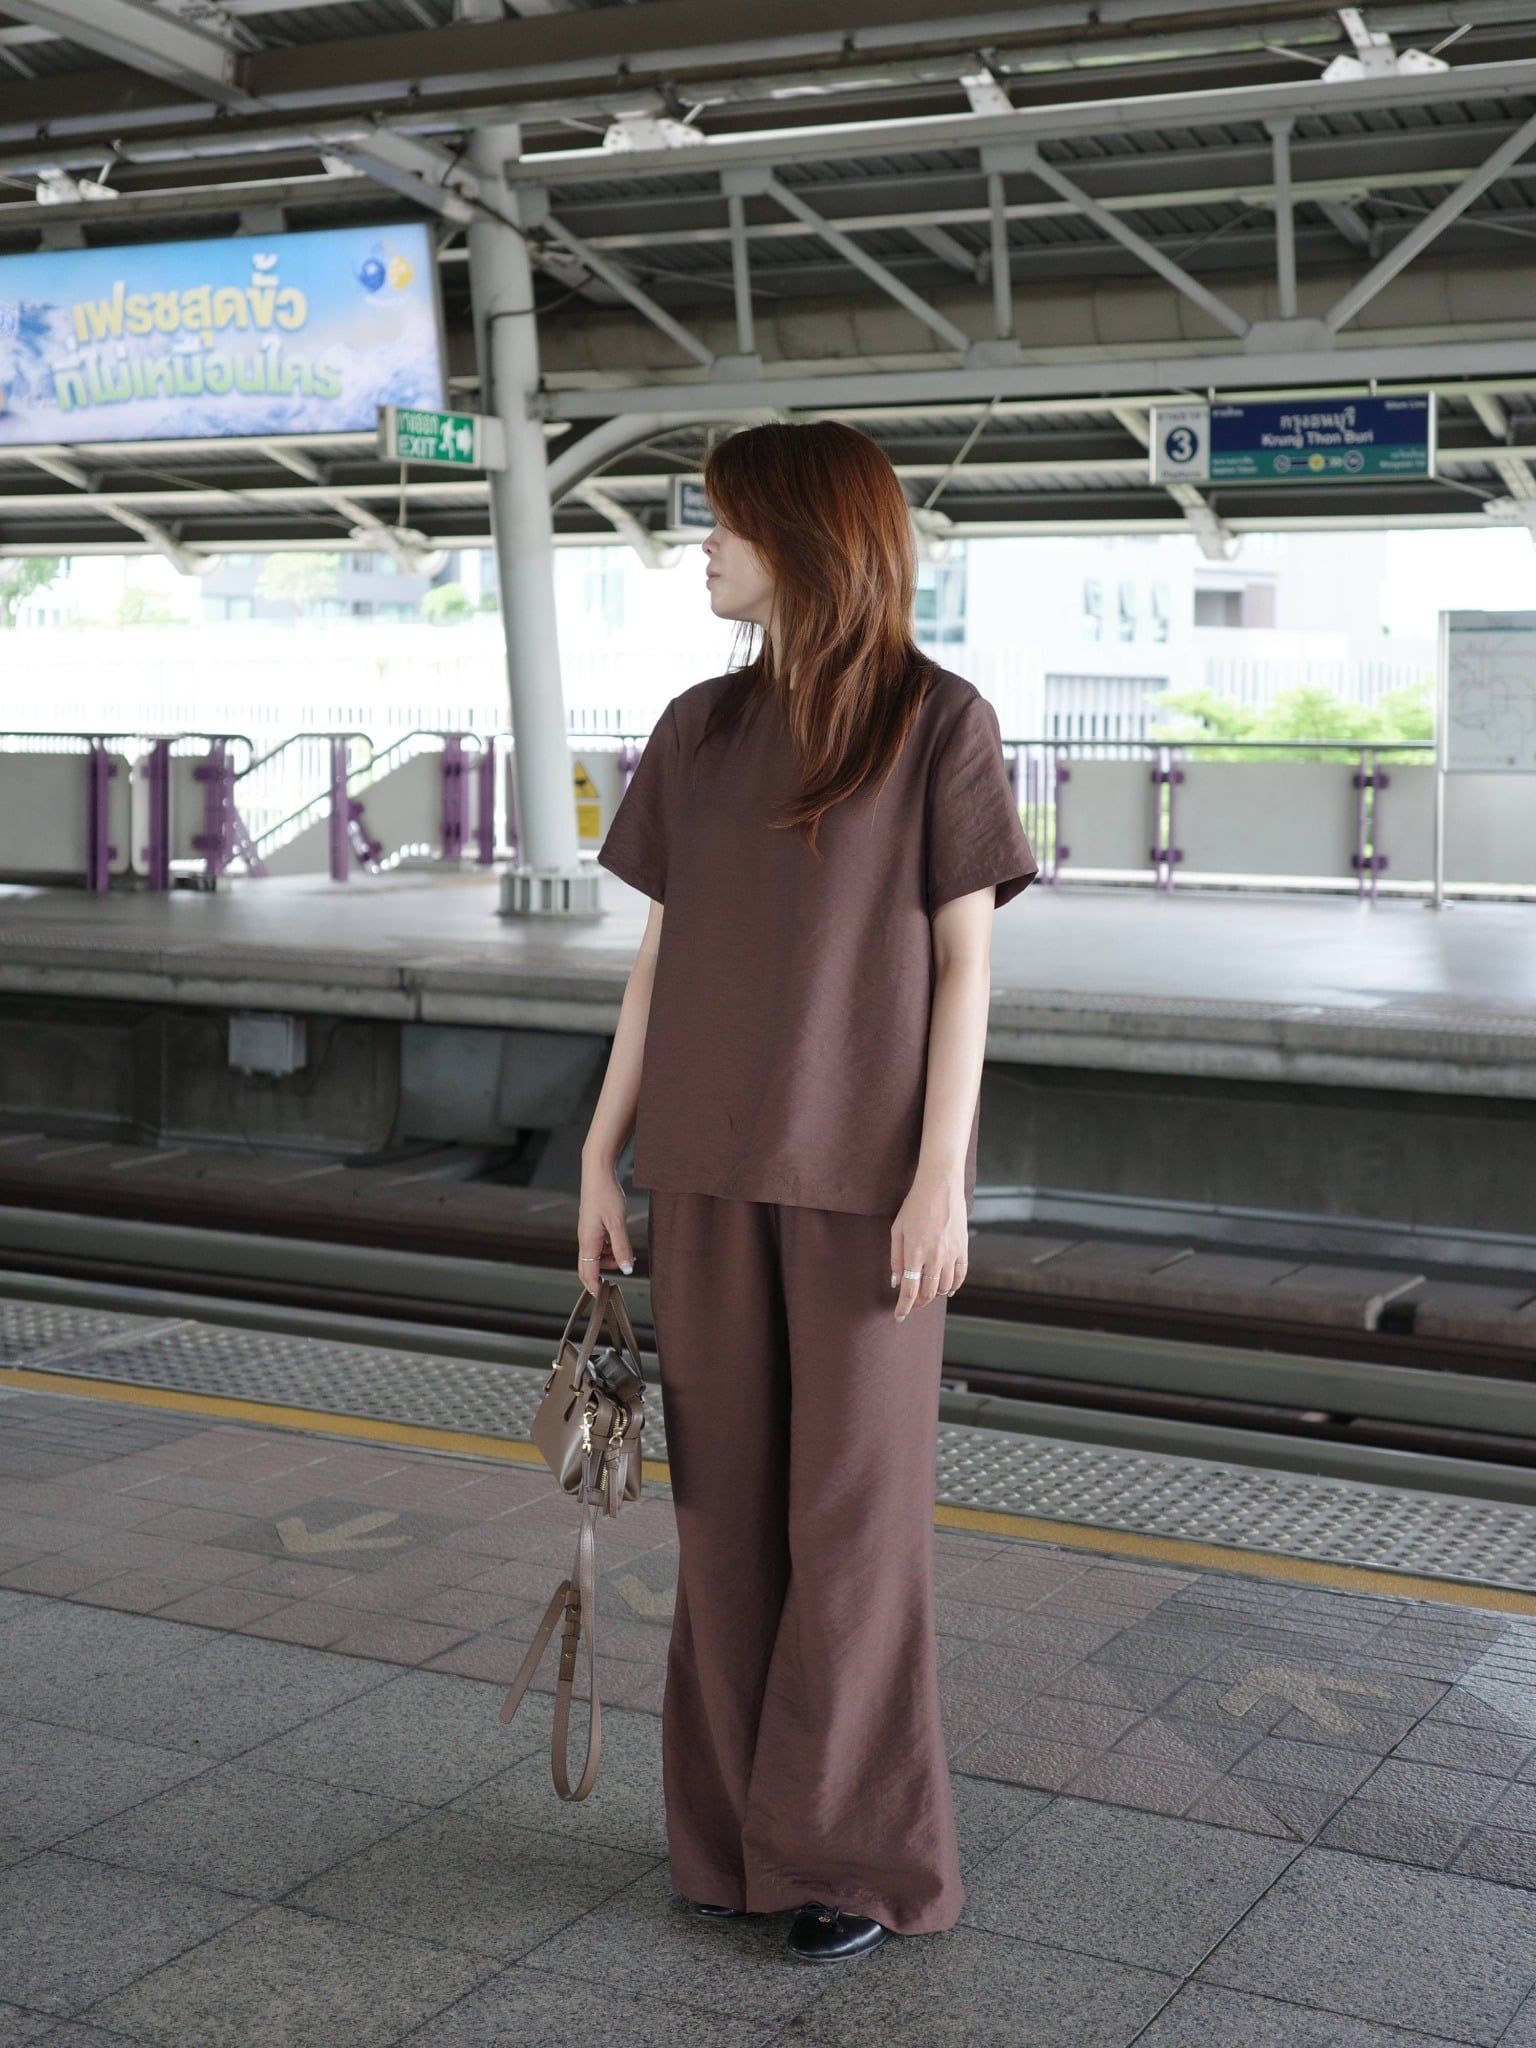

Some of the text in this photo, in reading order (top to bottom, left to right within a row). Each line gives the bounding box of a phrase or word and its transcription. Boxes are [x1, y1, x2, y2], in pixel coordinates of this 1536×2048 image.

[398, 434, 438, 458] EXIT
[1171, 430, 1193, 461] 3
[1262, 429, 1374, 449] Krung Thon Buri
